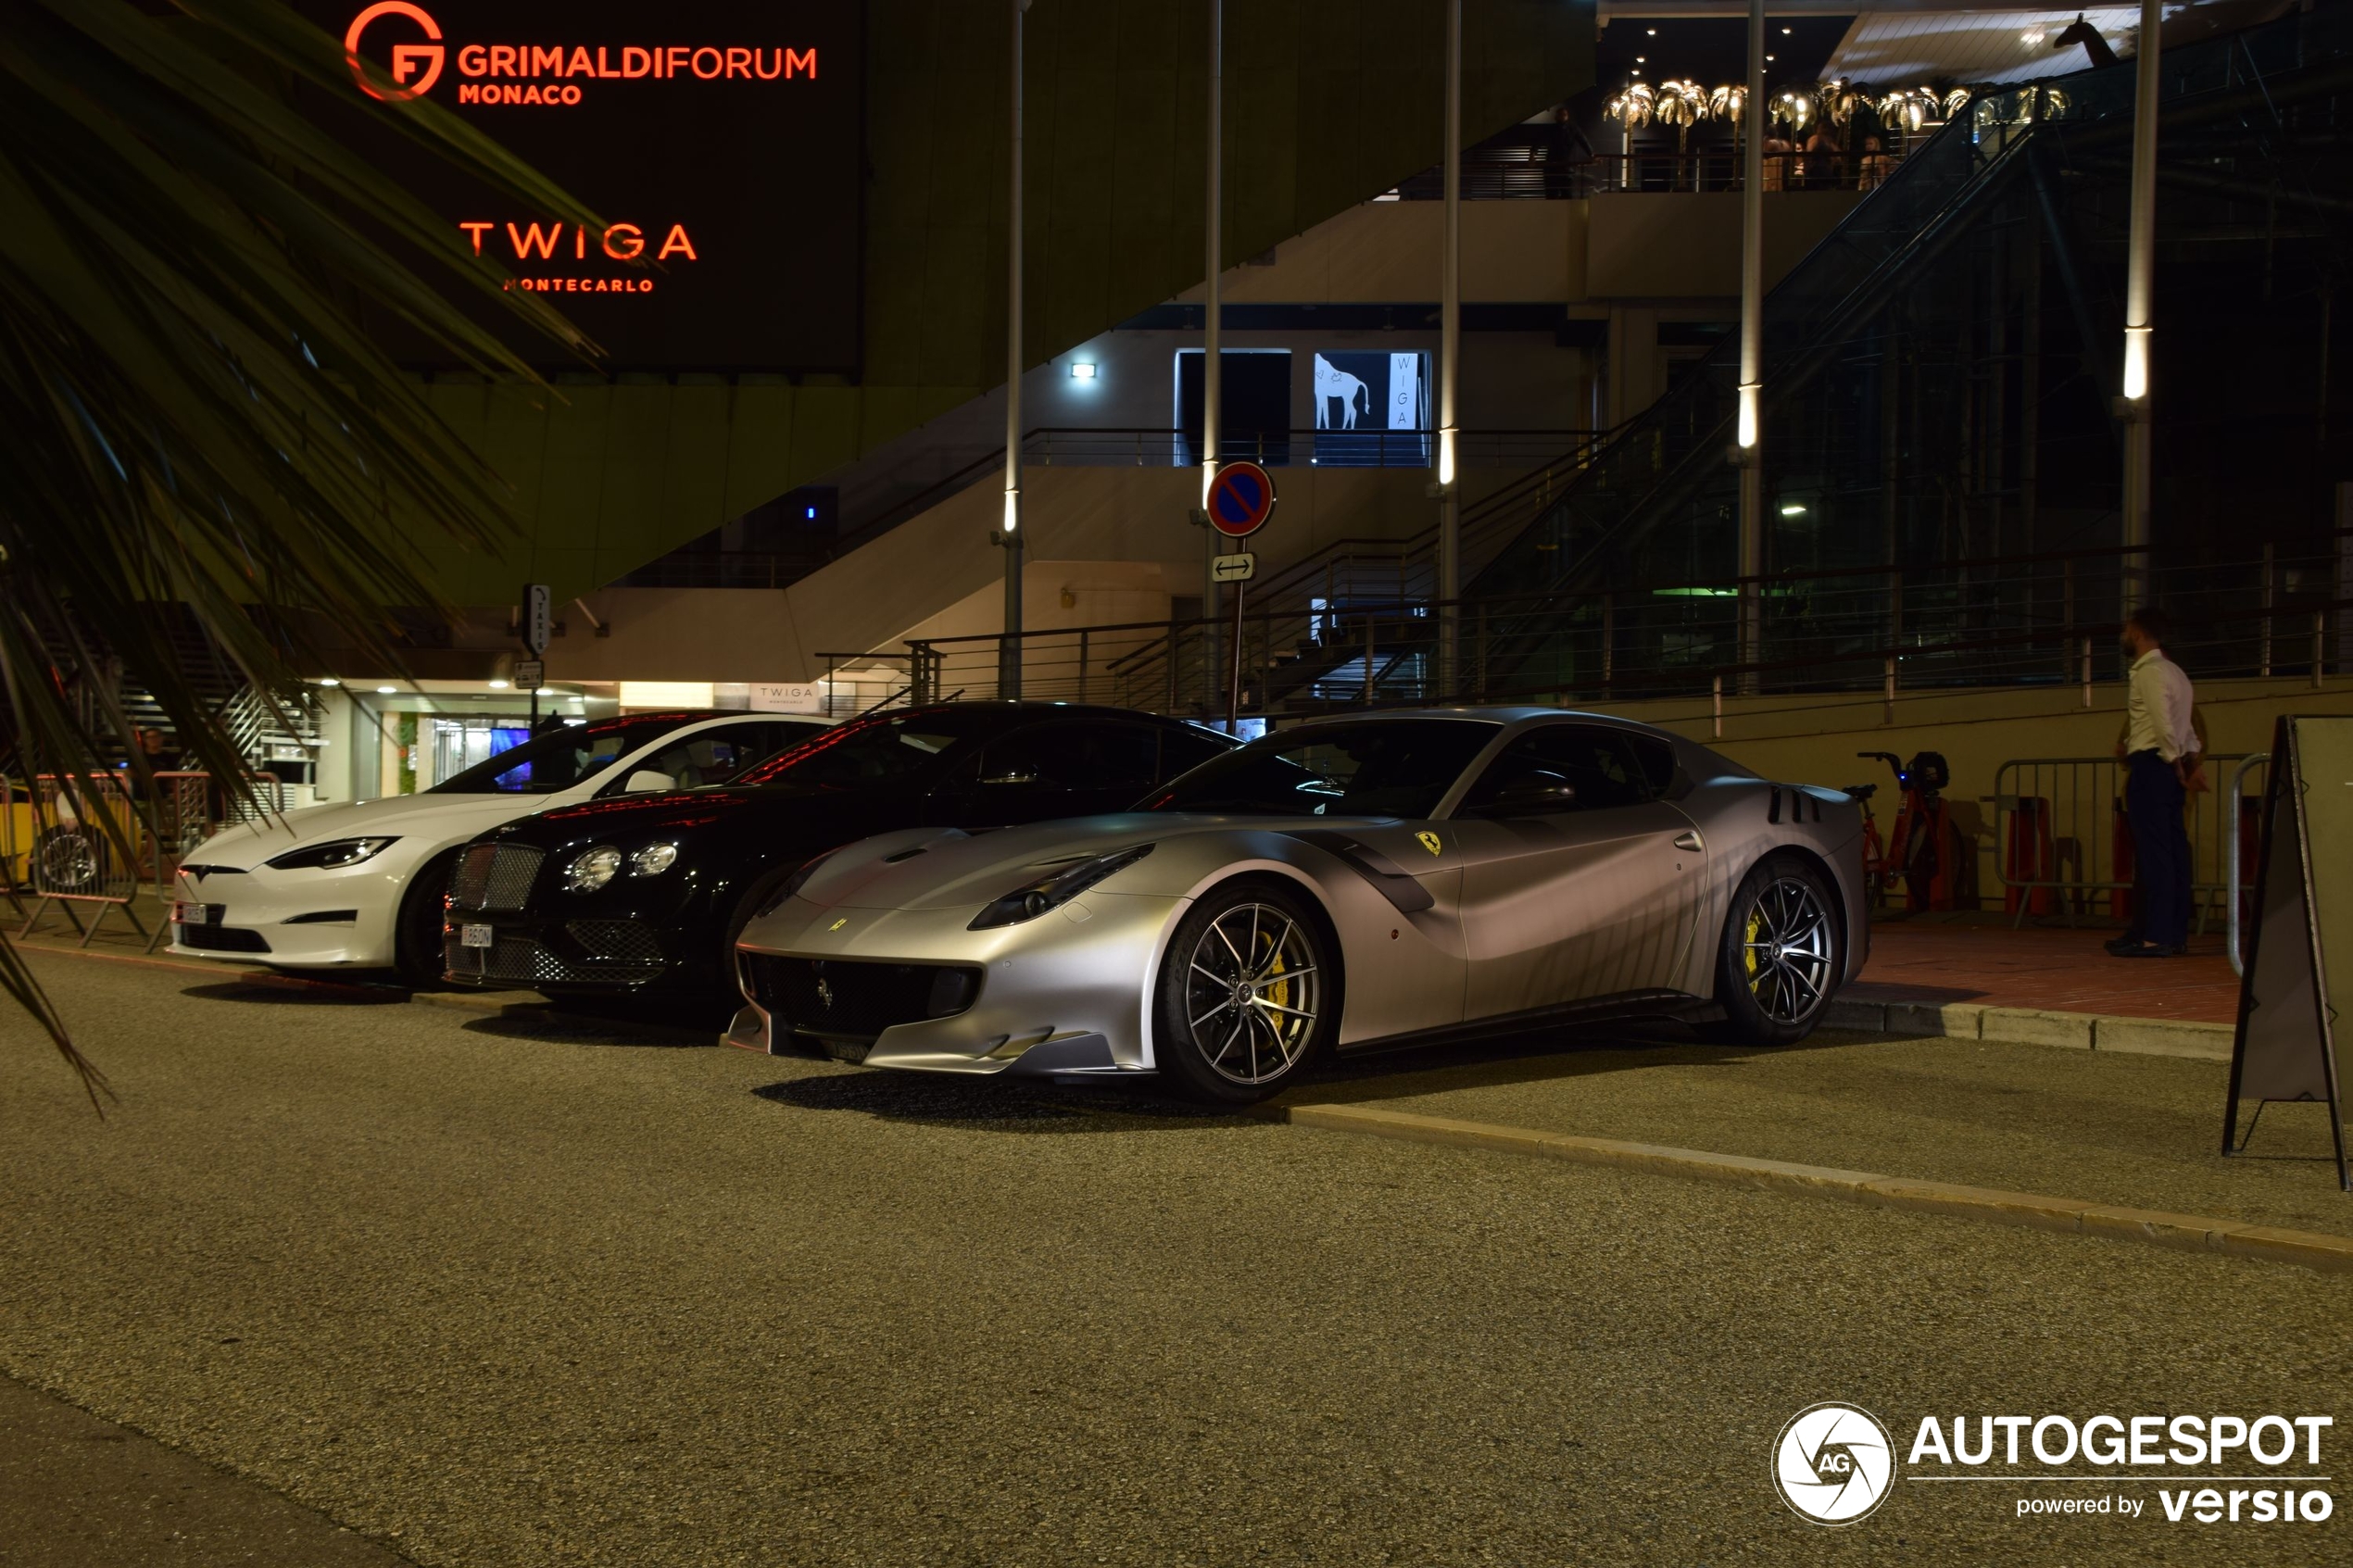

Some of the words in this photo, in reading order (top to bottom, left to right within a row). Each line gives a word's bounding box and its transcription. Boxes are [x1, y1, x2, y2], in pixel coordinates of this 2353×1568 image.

[459, 85, 582, 105] MONACO
[459, 221, 698, 261] TWIGA
[760, 687, 812, 697] TWIGA
